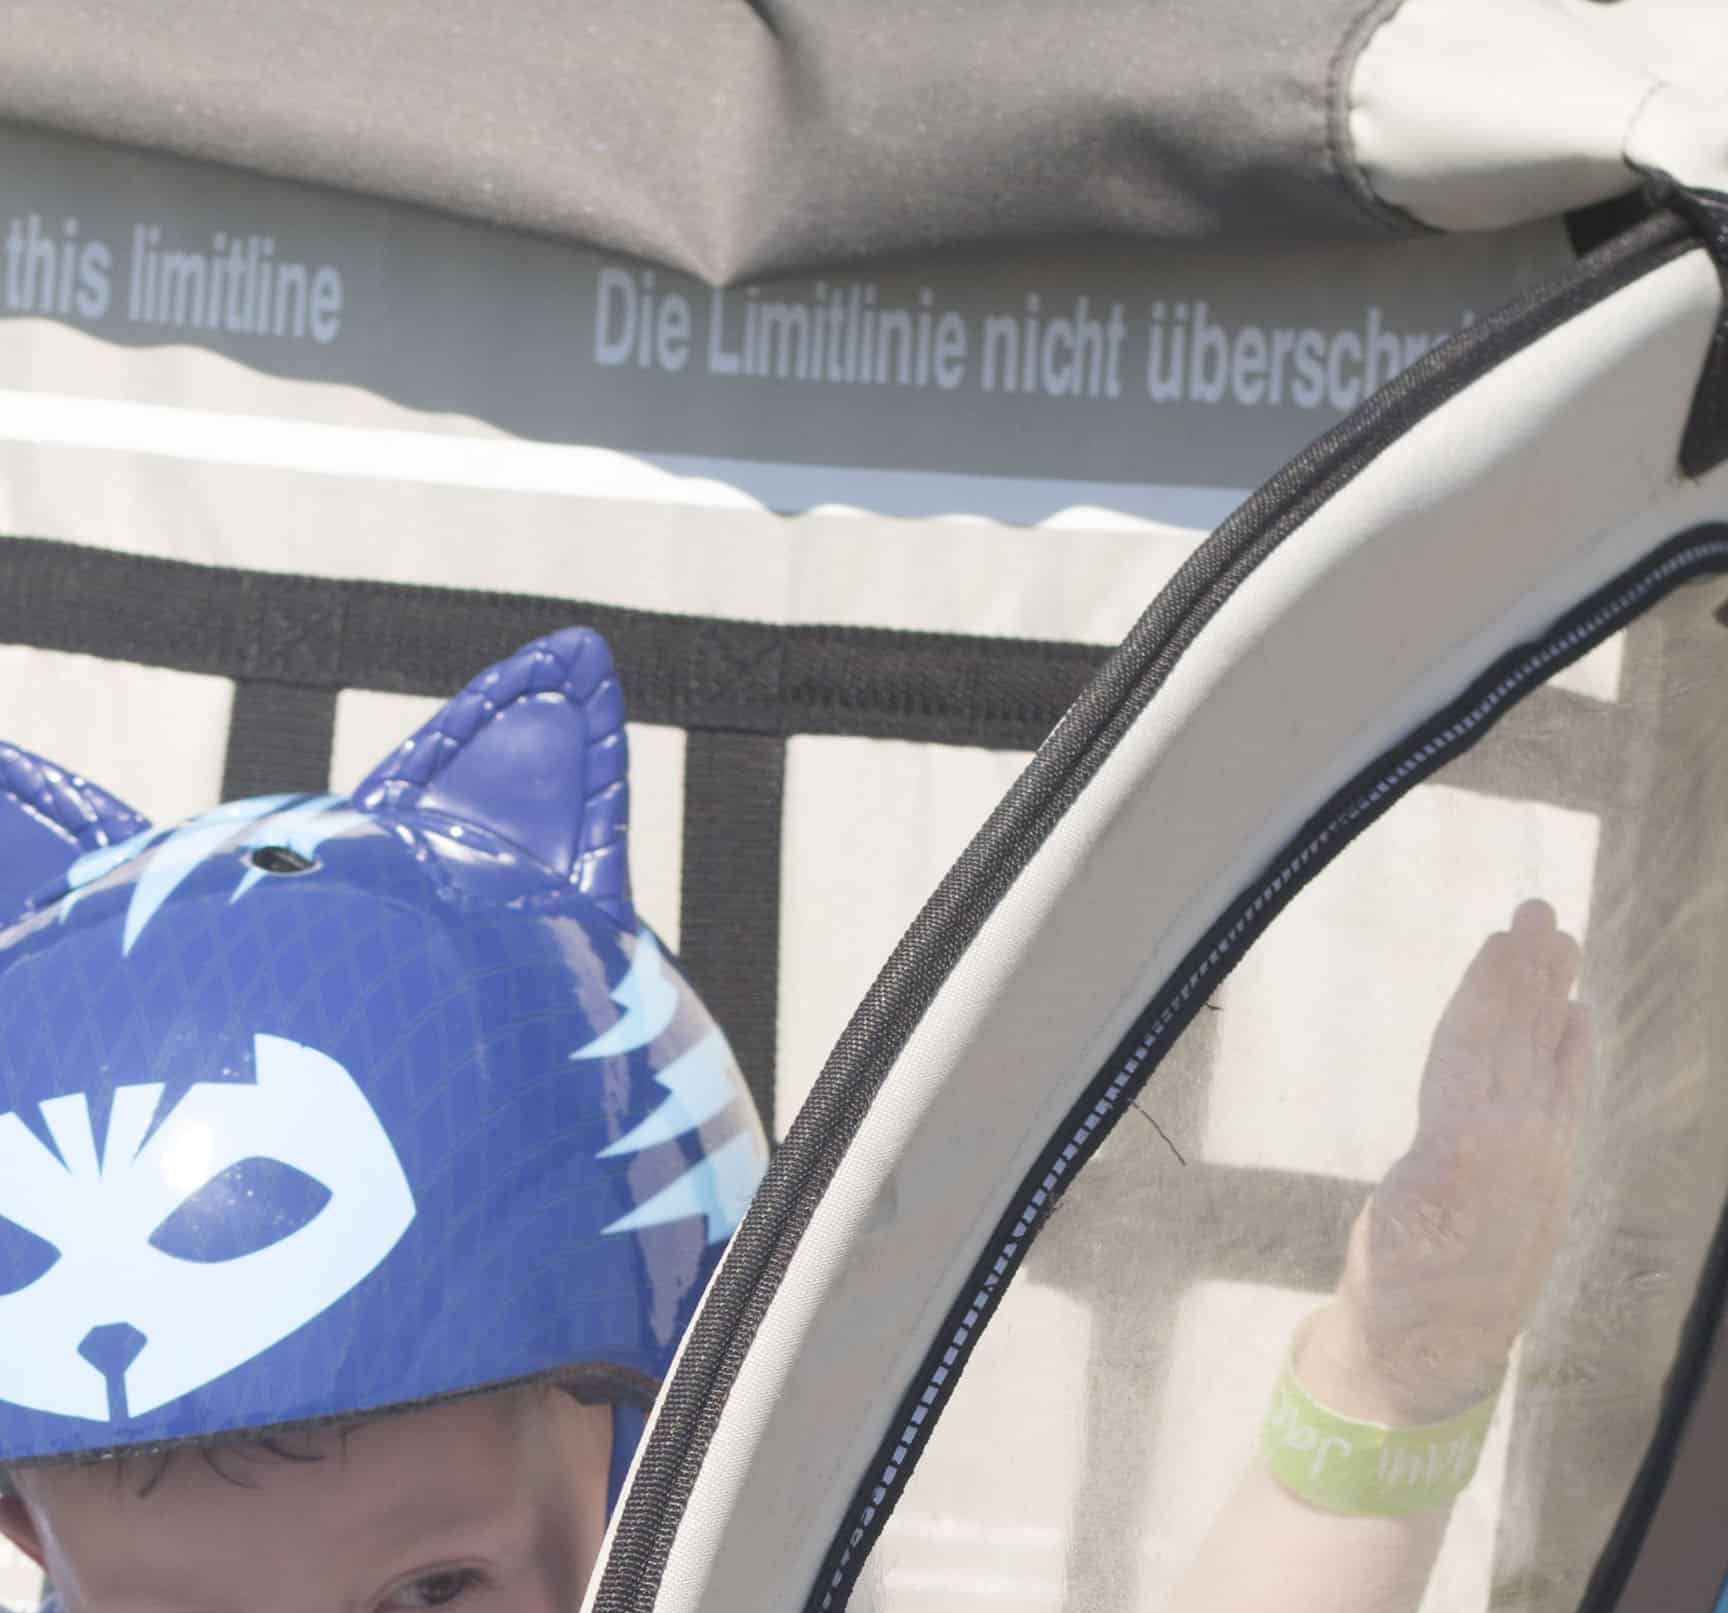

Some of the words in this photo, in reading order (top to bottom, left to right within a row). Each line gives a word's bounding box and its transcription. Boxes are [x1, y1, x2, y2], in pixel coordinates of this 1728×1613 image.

[5, 213, 113, 319] this
[127, 222, 344, 343] limitline
[593, 267, 691, 372] Die
[707, 280, 971, 390] Limitlinie
[980, 294, 1128, 399] nicht
